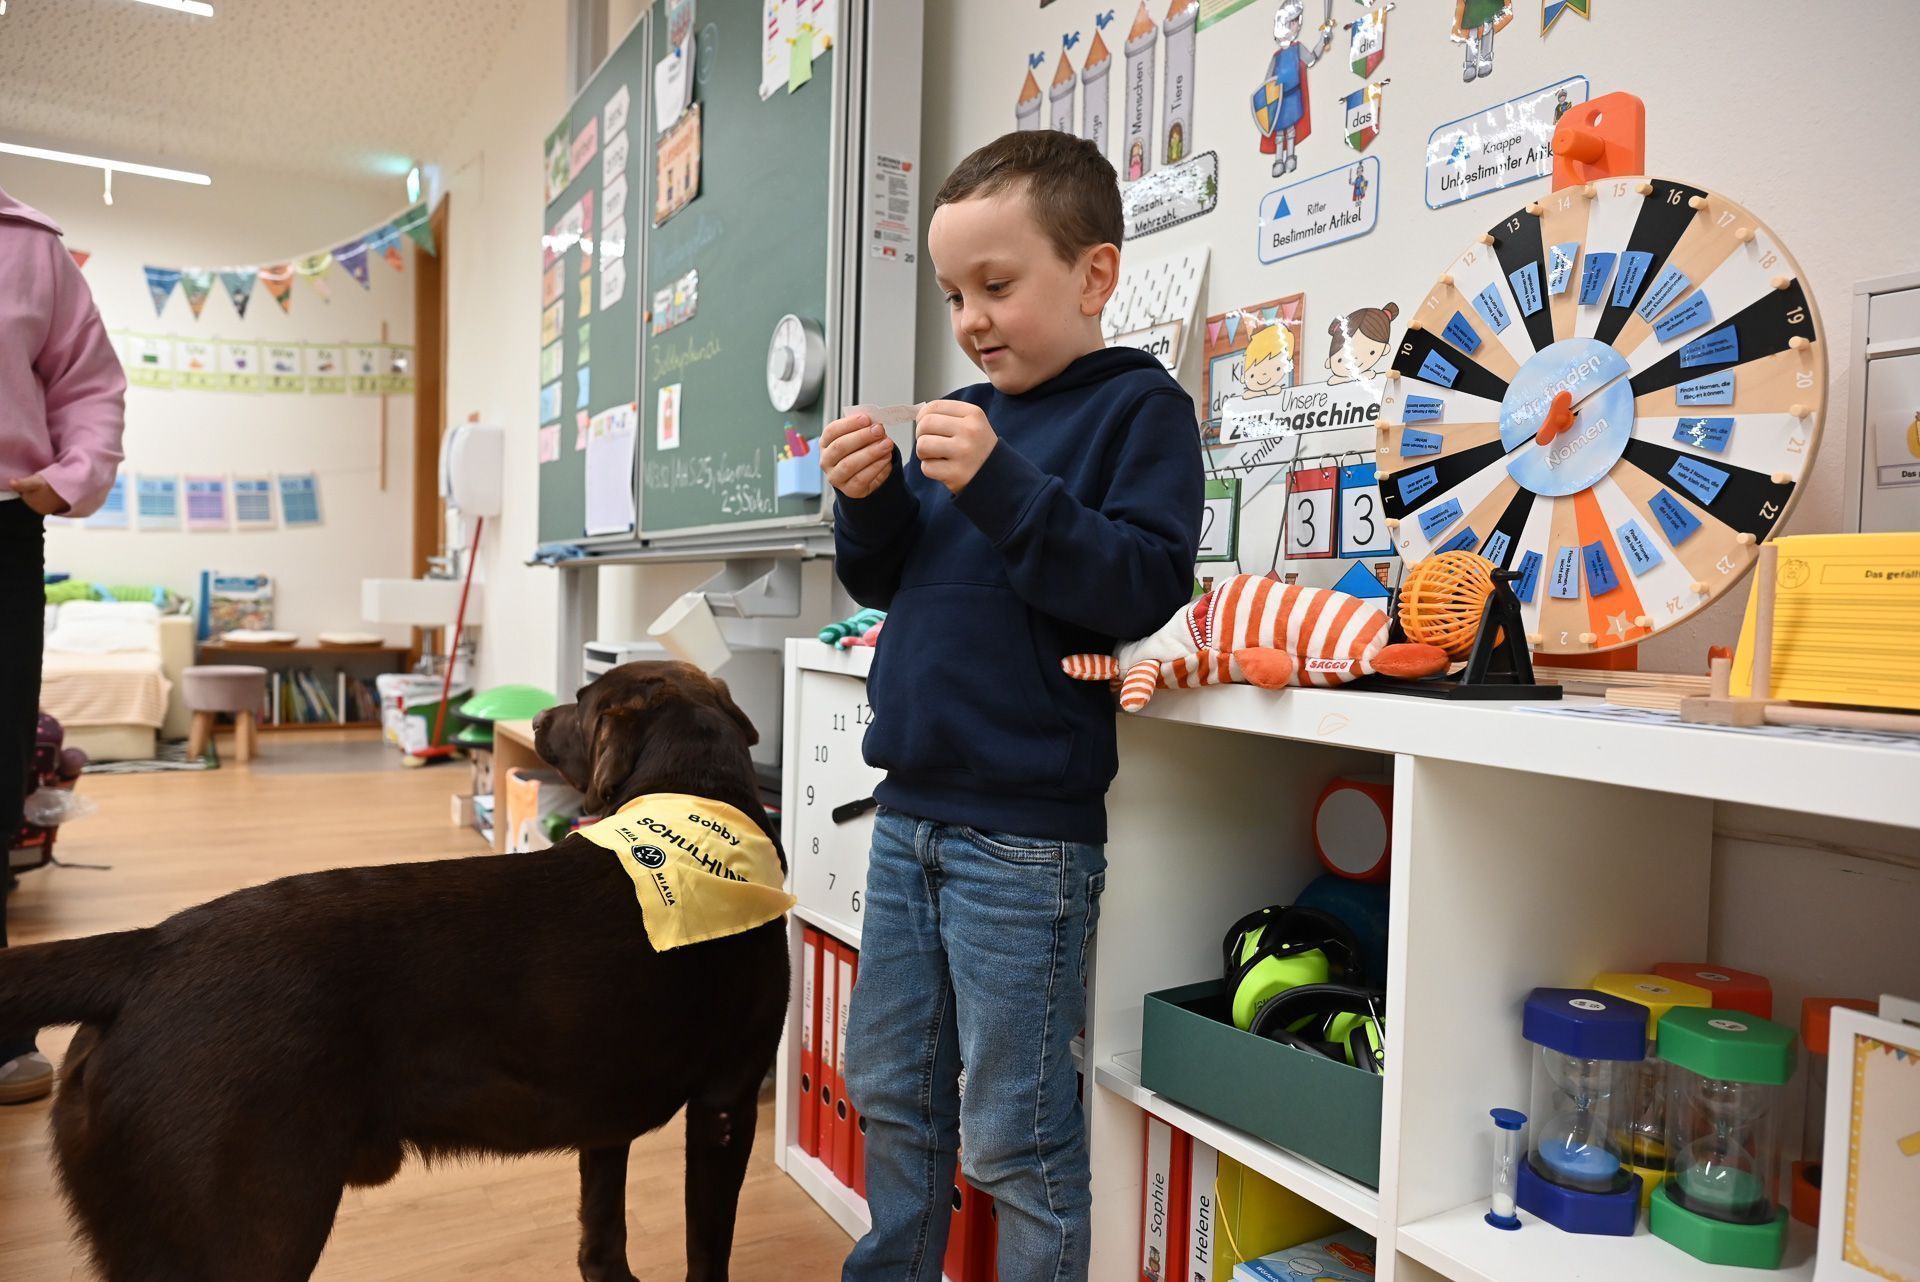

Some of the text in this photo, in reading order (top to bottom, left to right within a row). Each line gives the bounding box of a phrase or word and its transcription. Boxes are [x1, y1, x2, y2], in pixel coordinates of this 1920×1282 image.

[1360, 39, 1375, 53] die
[1132, 61, 1144, 135] Menschen
[1170, 75, 1183, 113] Tiere
[1352, 112, 1372, 128] das
[1482, 135, 1522, 155] Knappe
[1441, 154, 1522, 191] Unbestimmter
[1612, 183, 1626, 197] 15
[1667, 188, 1682, 205] 16
[1132, 196, 1164, 216] Einzahl
[1307, 202, 1327, 216] Ritter
[1558, 197, 1571, 211] 14
[1135, 208, 1177, 233] Mehrzahl
[1273, 206, 1361, 248] Bestimmter Artikel
[1507, 218, 1521, 233] 13
[1719, 211, 1735, 228] 17
[1463, 251, 1477, 267] 12
[1759, 250, 1778, 269] 18
[1616, 289, 1625, 304] Finde
[1621, 265, 1632, 285] Nomen
[1640, 298, 1653, 313] Finde
[1653, 280, 1670, 297] Nomen
[1667, 271, 1677, 281] aus
[1427, 296, 1440, 310] 11
[1642, 305, 1656, 318] dem
[1655, 319, 1670, 331] Finde
[1693, 299, 1703, 308] die
[1786, 306, 1805, 324] 19
[1401, 343, 1413, 356] 10
[1544, 354, 1601, 403] finden
[1796, 371, 1813, 388] 20
[1281, 390, 1328, 412] Unsere
[1544, 417, 1608, 471] Nomen
[1787, 437, 1806, 453] 21
[1676, 462, 1690, 472] Finde
[1710, 480, 1719, 488] die
[1901, 470, 1916, 478] Das
[1385, 495, 1395, 503] 7
[1759, 501, 1778, 519] 22
[1199, 506, 1215, 550] 2
[1297, 498, 1315, 547] 3
[1353, 494, 1375, 545] 3
[1623, 534, 1632, 543] die
[1627, 528, 1639, 542] Finde
[1716, 555, 1735, 574] 23
[1865, 569, 1883, 579] Das
[1666, 596, 1683, 614] 24
[1616, 618, 1623, 632] 1
[1560, 631, 1568, 645] 2
[833, 714, 846, 731] 11
[856, 704, 874, 725] 12
[815, 745, 828, 763] 10
[806, 785, 815, 805] 9
[688, 814, 740, 846] Bobby
[812, 837, 820, 854] 8
[656, 872, 676, 906] MIAUA
[828, 873, 836, 890] 7
[852, 891, 861, 912] 6
[1151, 1172, 1166, 1237] Sophie
[1195, 1195, 1210, 1264] Helene
